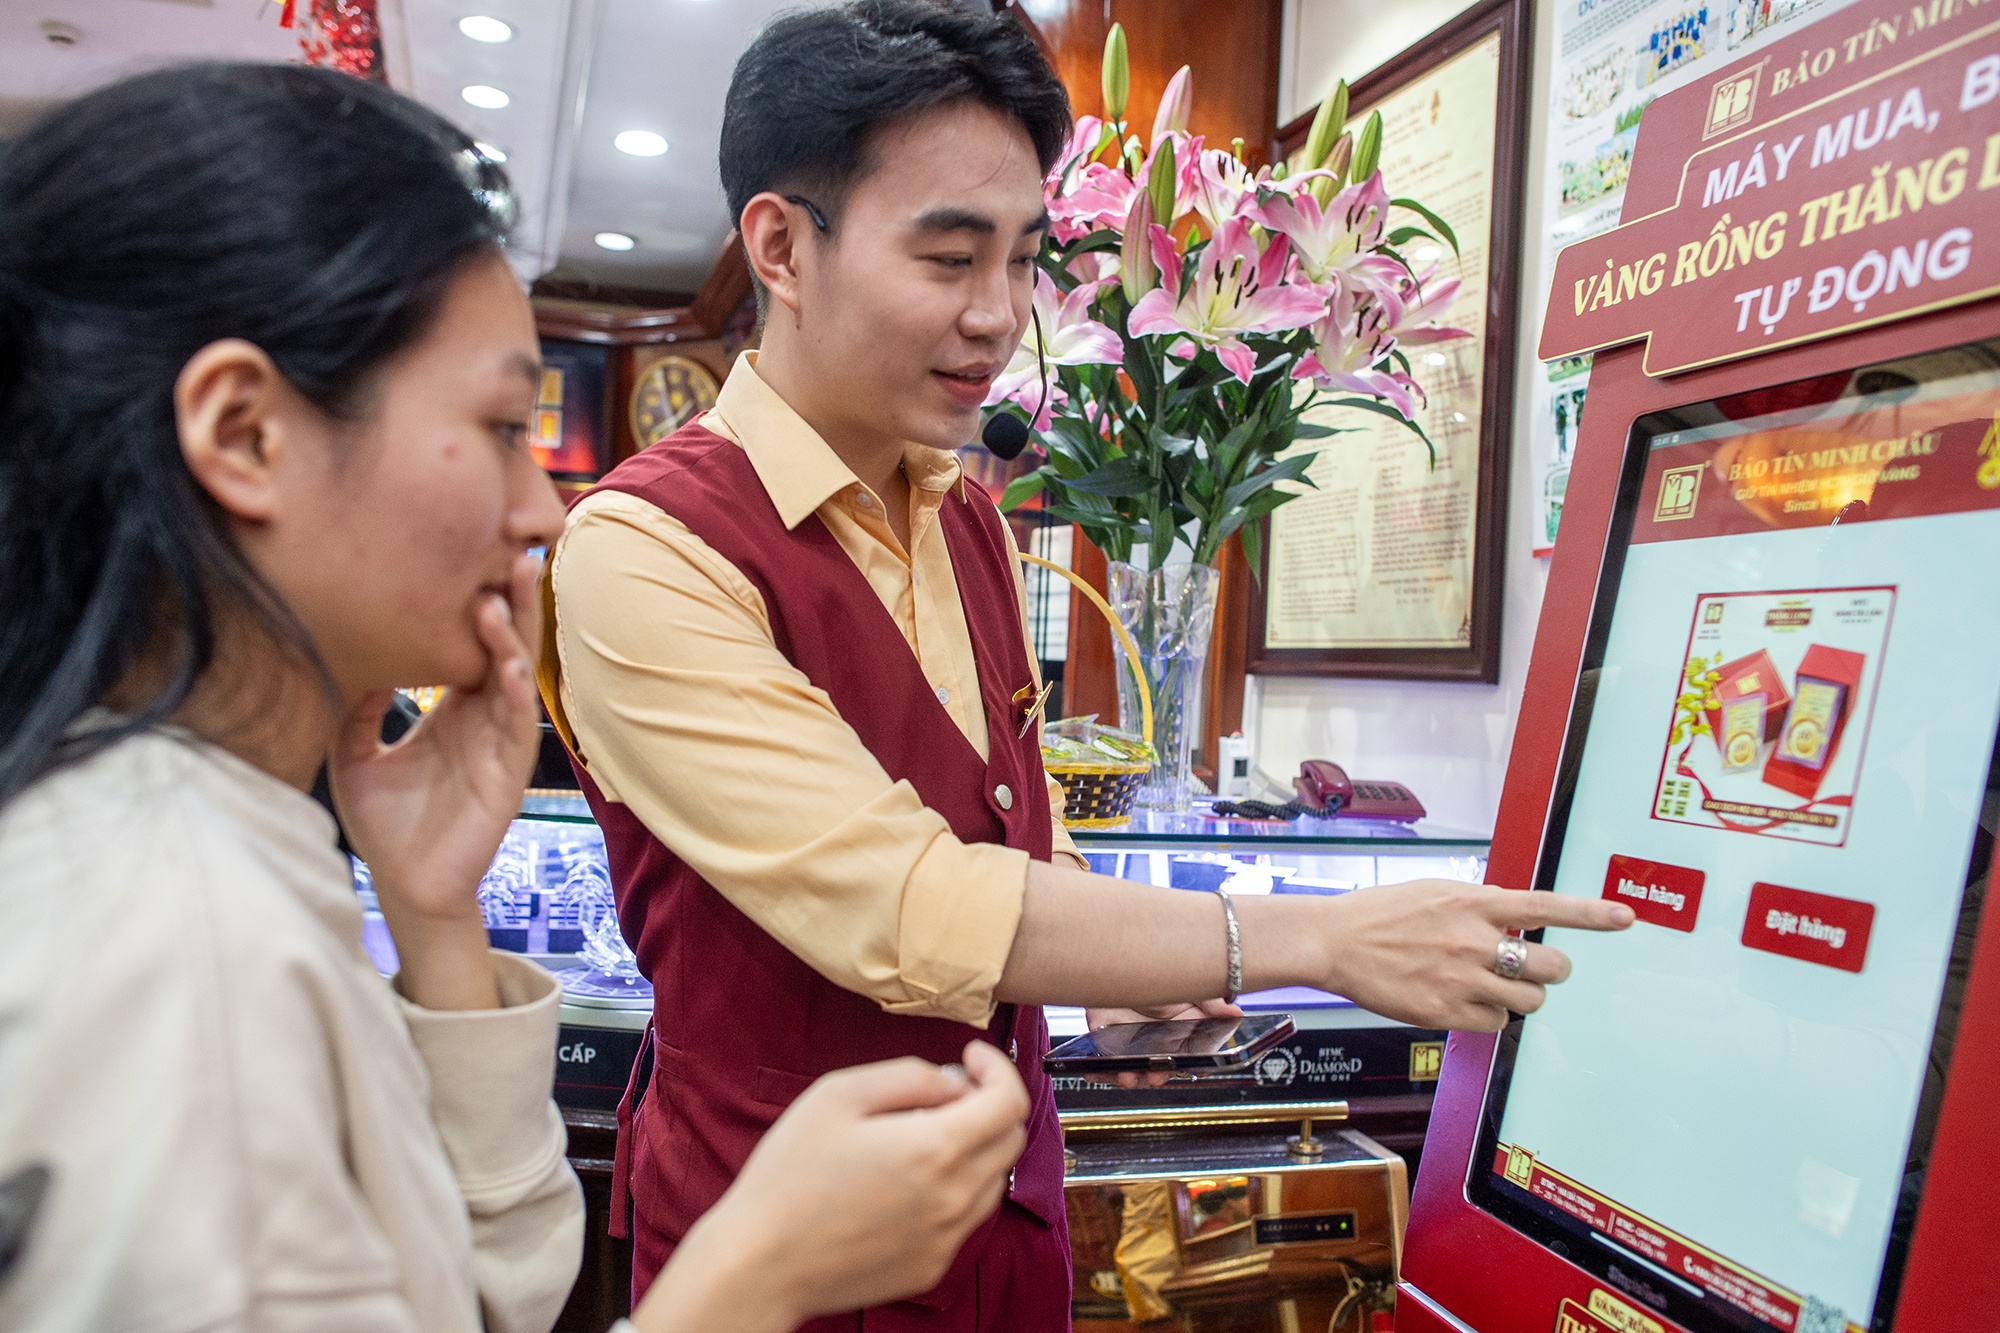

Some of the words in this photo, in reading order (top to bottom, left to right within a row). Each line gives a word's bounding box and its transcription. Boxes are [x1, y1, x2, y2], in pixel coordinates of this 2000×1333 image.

[1769, 47, 1836, 97] BẢO
[1841, 14, 1902, 64] TÍN
[1701, 133, 1805, 208] MÁY
[1809, 86, 1941, 169] MUA,
[1574, 258, 1667, 316] VÀNG
[1670, 211, 1788, 287] RỒNG
[1798, 146, 1970, 248] THĂNG
[1733, 275, 1802, 336] TỰ
[1807, 226, 1973, 314] ĐỘNG
[1617, 877, 1648, 900] Mua
[1648, 883, 1686, 912] hàng
[1798, 914, 1847, 949] hàng
[558, 1041, 597, 1064] CẤP
[1300, 1057, 1363, 1076] DIAMOND
